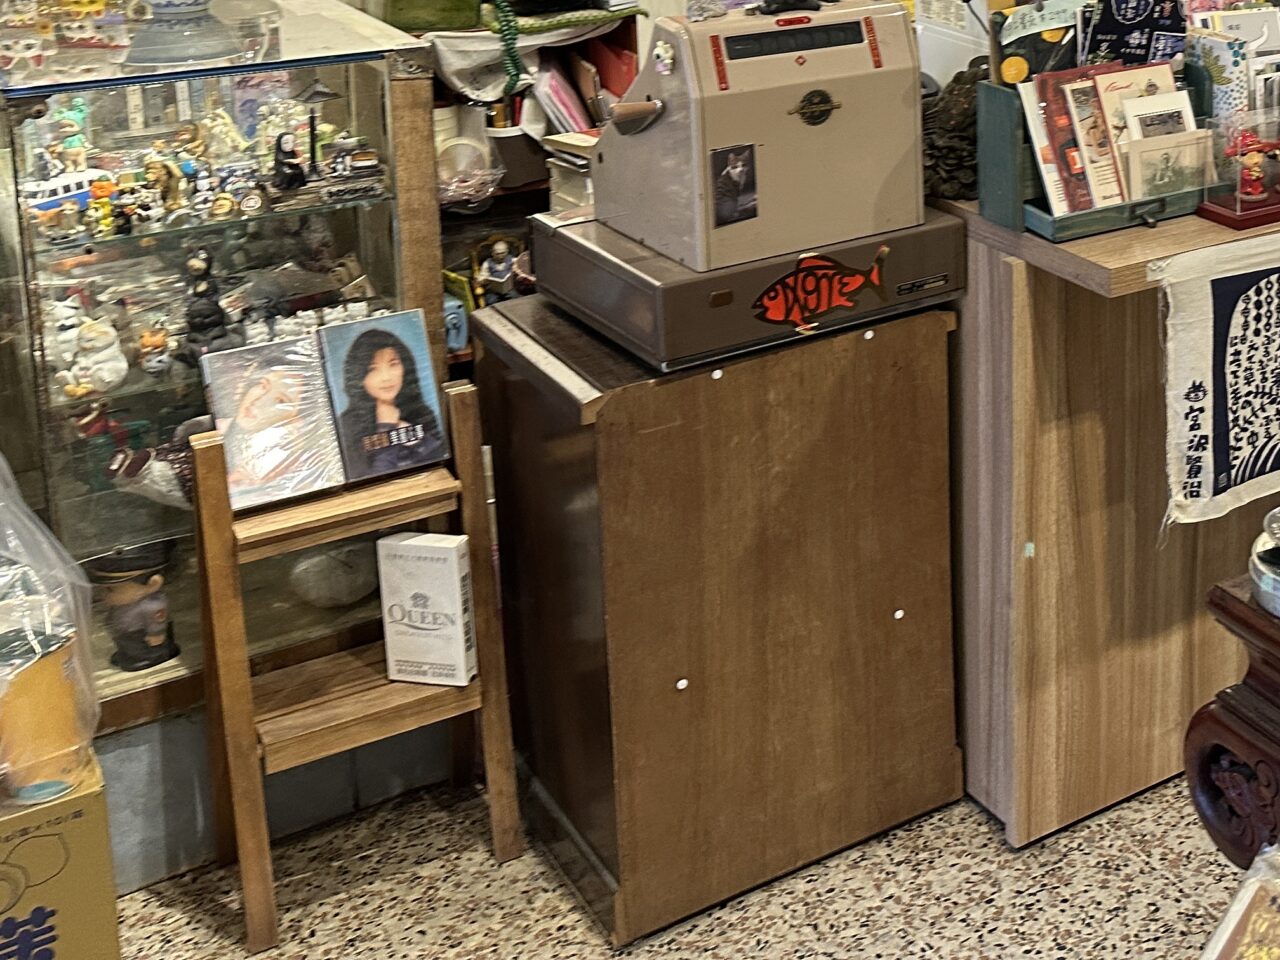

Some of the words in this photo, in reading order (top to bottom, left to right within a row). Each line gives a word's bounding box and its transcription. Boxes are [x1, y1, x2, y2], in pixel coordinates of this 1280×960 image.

[1182, 405, 1209, 500] 宮沢賢治
[387, 603, 457, 629] QUEEN
